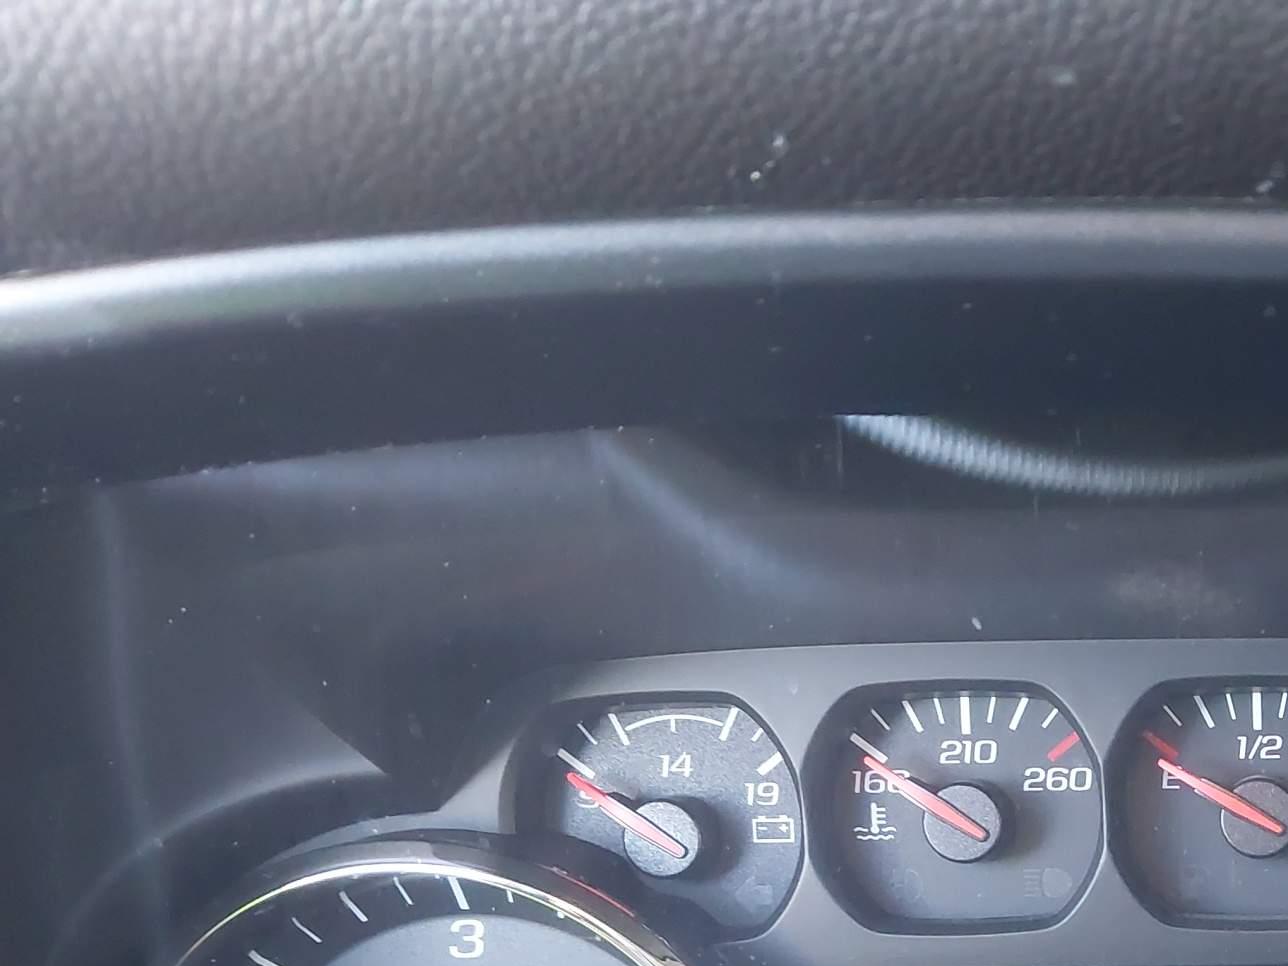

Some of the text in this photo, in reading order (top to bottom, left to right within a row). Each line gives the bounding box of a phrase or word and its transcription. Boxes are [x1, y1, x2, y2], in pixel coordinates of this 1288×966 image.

[939, 739, 997, 764] 210
[1237, 735, 1283, 760] 1/2
[658, 751, 694, 778] 14
[1023, 767, 1093, 792] 260
[743, 782, 780, 806] 19
[448, 919, 485, 959] 3
